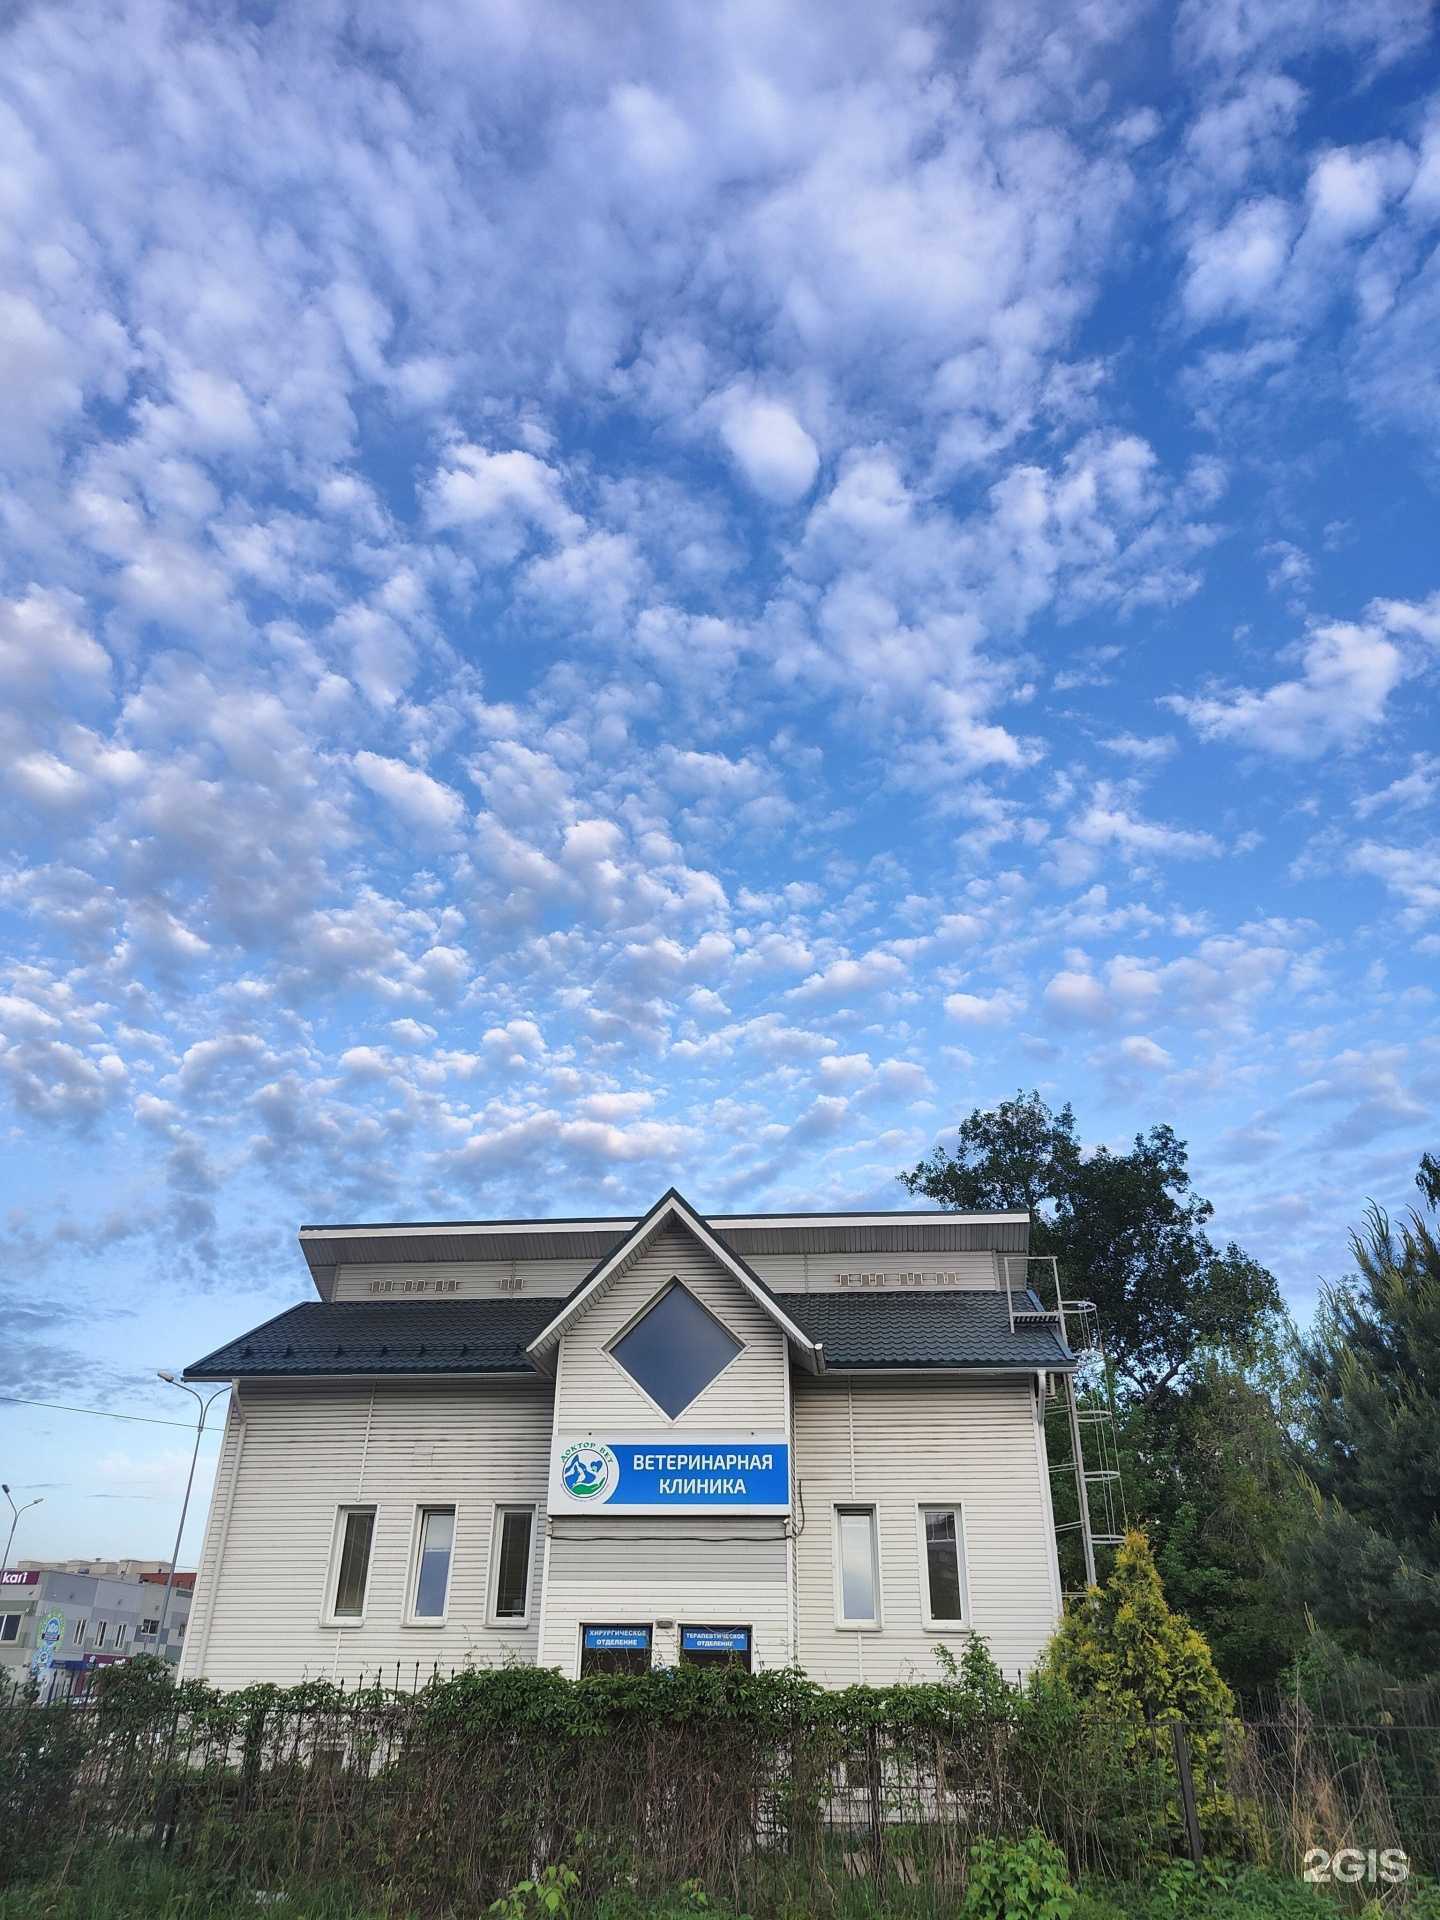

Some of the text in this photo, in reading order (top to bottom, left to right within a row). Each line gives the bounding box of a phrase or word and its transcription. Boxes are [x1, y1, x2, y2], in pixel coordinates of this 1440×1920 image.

[560, 1442, 614, 1463] ДОКТОР ВЕТ
[633, 1454, 773, 1470] ВЕТЕРИНАРНАЯ
[659, 1478, 747, 1494] КЛИНИКА
[2, 1572, 28, 1583] kari
[589, 1629, 647, 1637] ХИРУРГИЧЕСКОЕ
